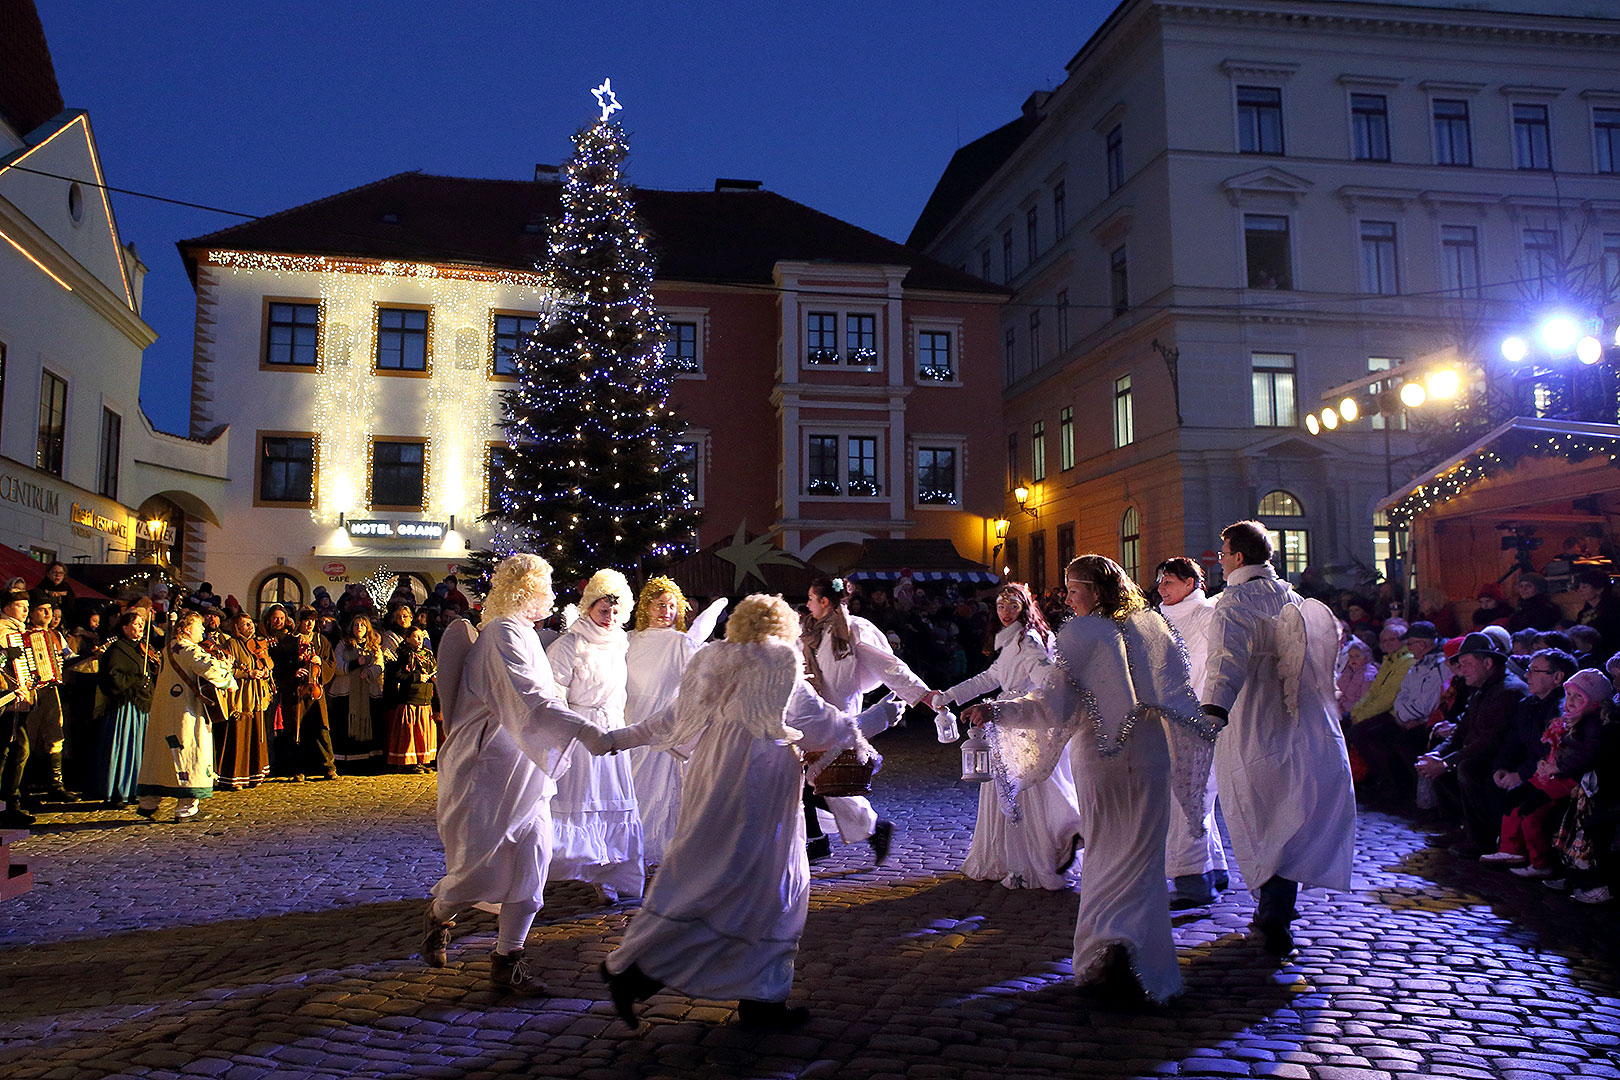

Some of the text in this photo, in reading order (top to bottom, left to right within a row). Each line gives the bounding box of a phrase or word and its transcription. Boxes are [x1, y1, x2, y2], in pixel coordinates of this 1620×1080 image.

[0, 474, 59, 516] CENTRUM
[351, 523, 443, 537] HOTEL GRAND
[328, 574, 350, 583] CAFÉ
